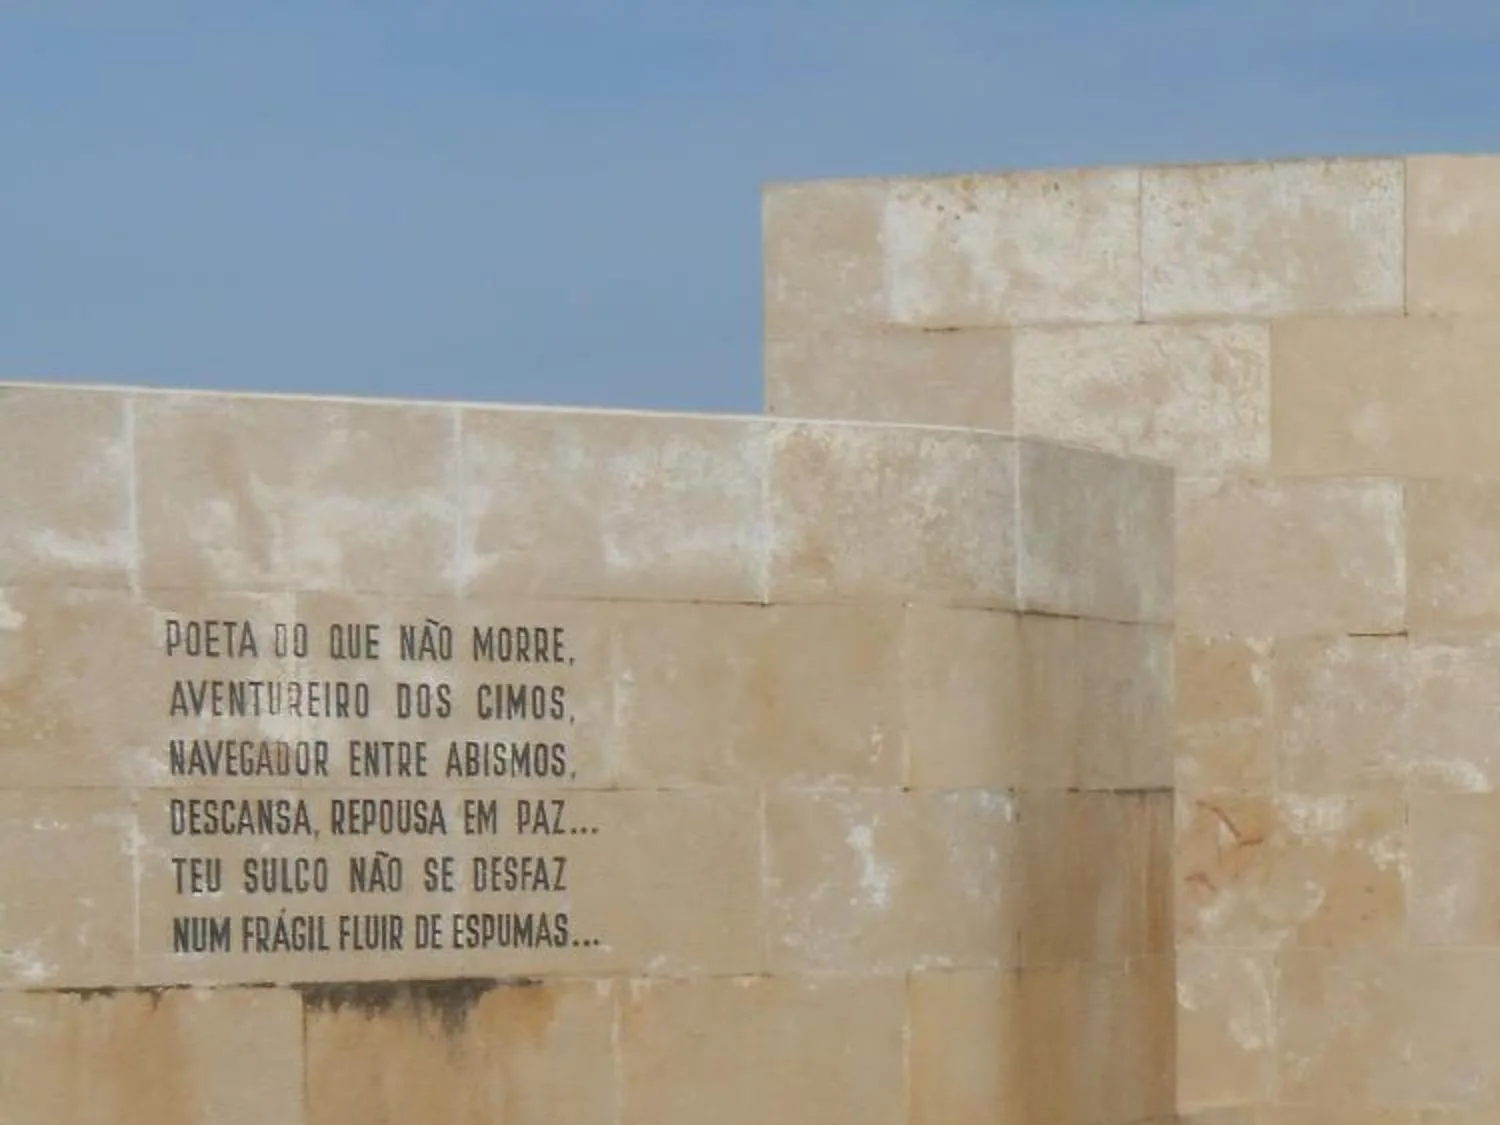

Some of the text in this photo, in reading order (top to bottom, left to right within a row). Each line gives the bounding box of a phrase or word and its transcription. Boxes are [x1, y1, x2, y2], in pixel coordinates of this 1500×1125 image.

[165, 619, 575, 665] POETA DO QUE NÃO MORRE,
[170, 681, 575, 724] AVENTUREIRO DOS CIMOS,
[170, 740, 576, 780] NAVEGADOR ENTRE ABISMOS,
[171, 799, 598, 839] DESCANSA, REPOUSA EM PAZ...
[172, 851, 567, 894] TEU SULCO NÃO SE DESFAZ
[173, 907, 599, 953] NUM FRÁGIL FLUIR DE ESPUMAS...
